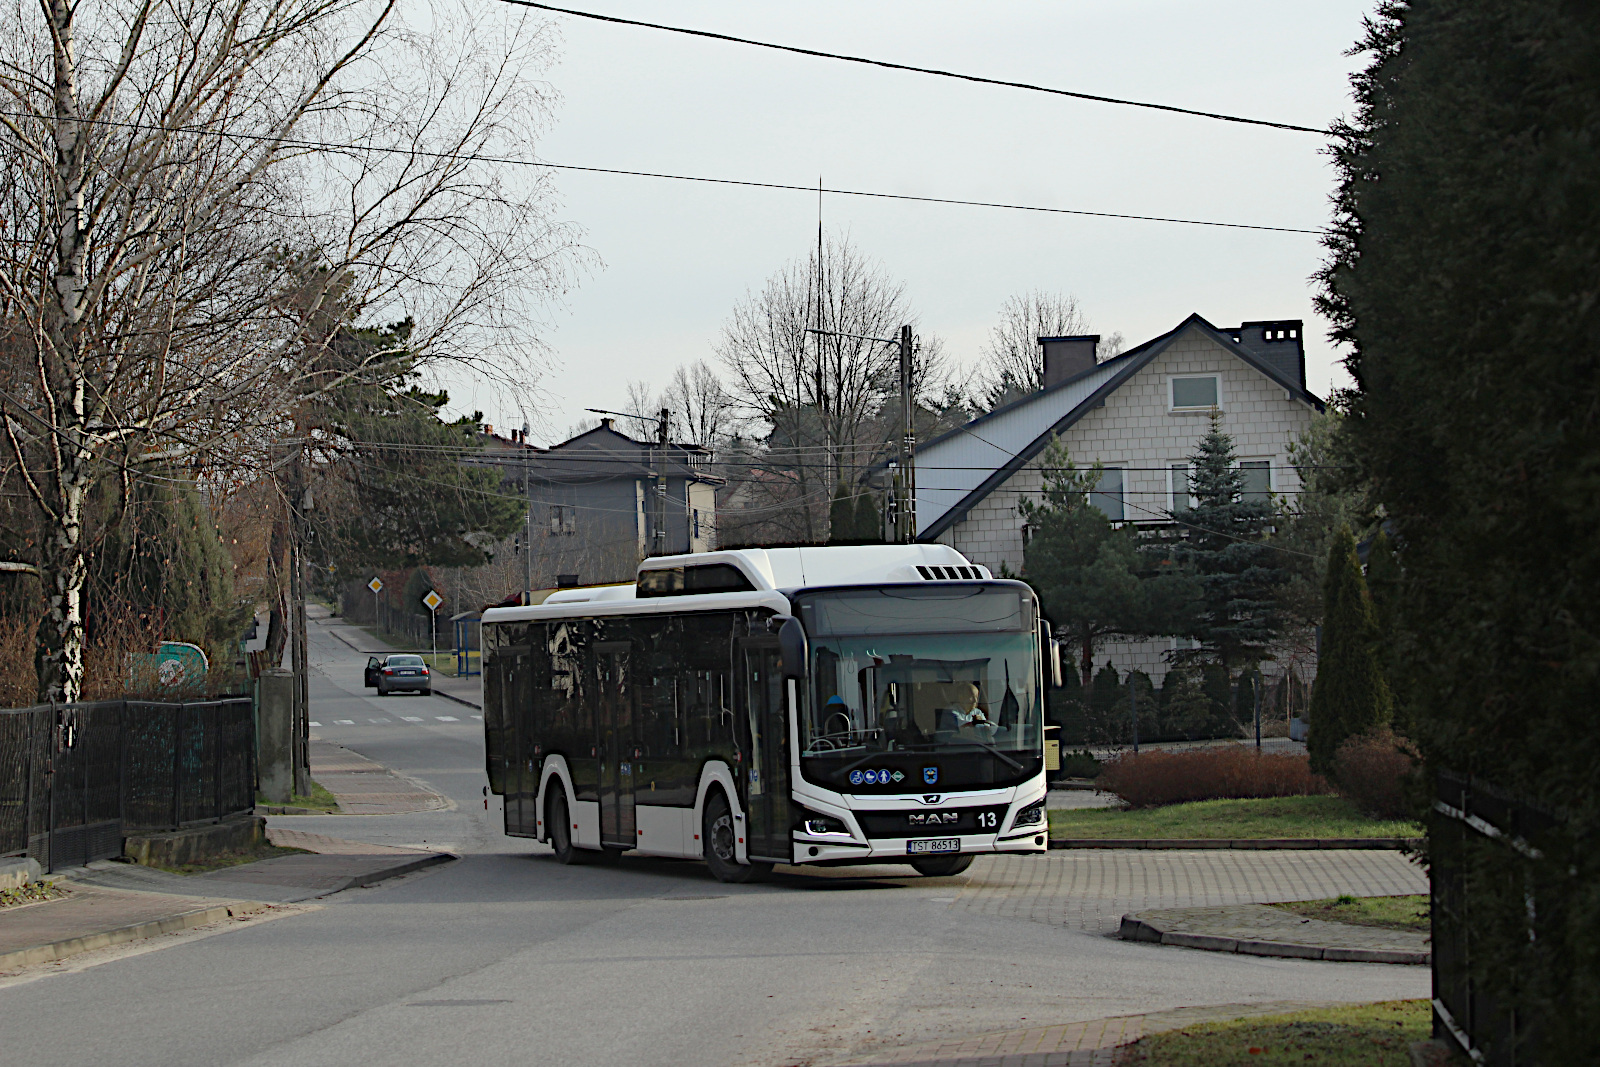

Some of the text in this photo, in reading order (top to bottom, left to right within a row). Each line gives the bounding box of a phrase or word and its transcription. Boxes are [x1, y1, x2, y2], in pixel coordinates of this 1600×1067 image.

[908, 812, 958, 825] MAN
[978, 812, 997, 827] 13
[912, 840, 958, 851] TST 86513
